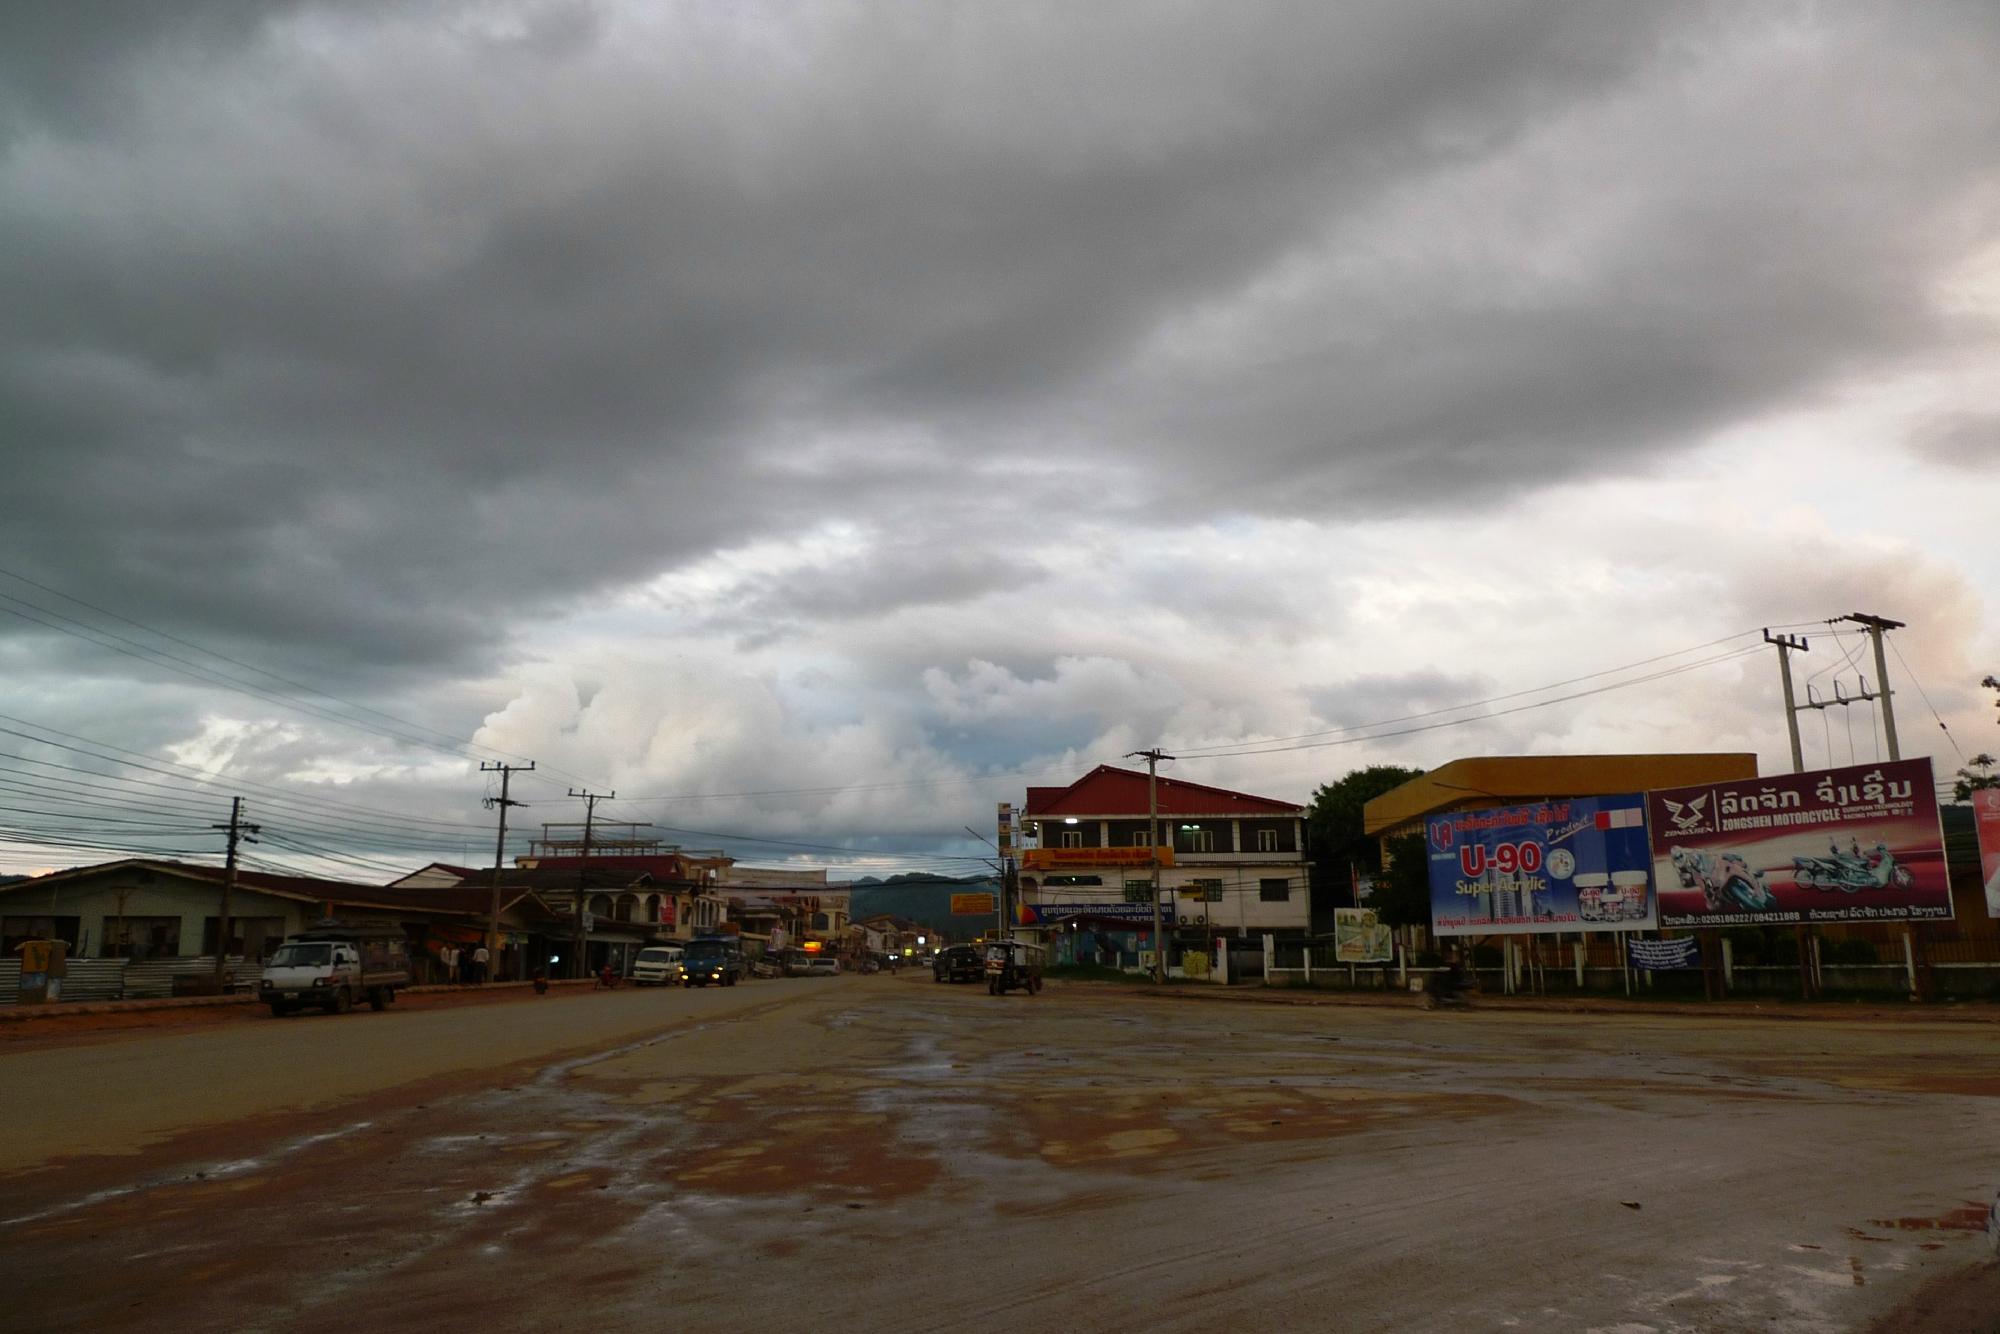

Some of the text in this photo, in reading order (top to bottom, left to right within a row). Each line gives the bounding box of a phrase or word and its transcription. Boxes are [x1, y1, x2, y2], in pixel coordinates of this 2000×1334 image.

[1874, 801, 1914, 811] TECHNOLOGY
[1546, 814, 1589, 838] Product
[1722, 807, 1841, 831] ZONGSHEN MOTORCYCLE
[1664, 827, 1714, 837] ZONGSHEN
[1460, 841, 1542, 878] U-90
[1456, 875, 1547, 898] Super Acrylic
